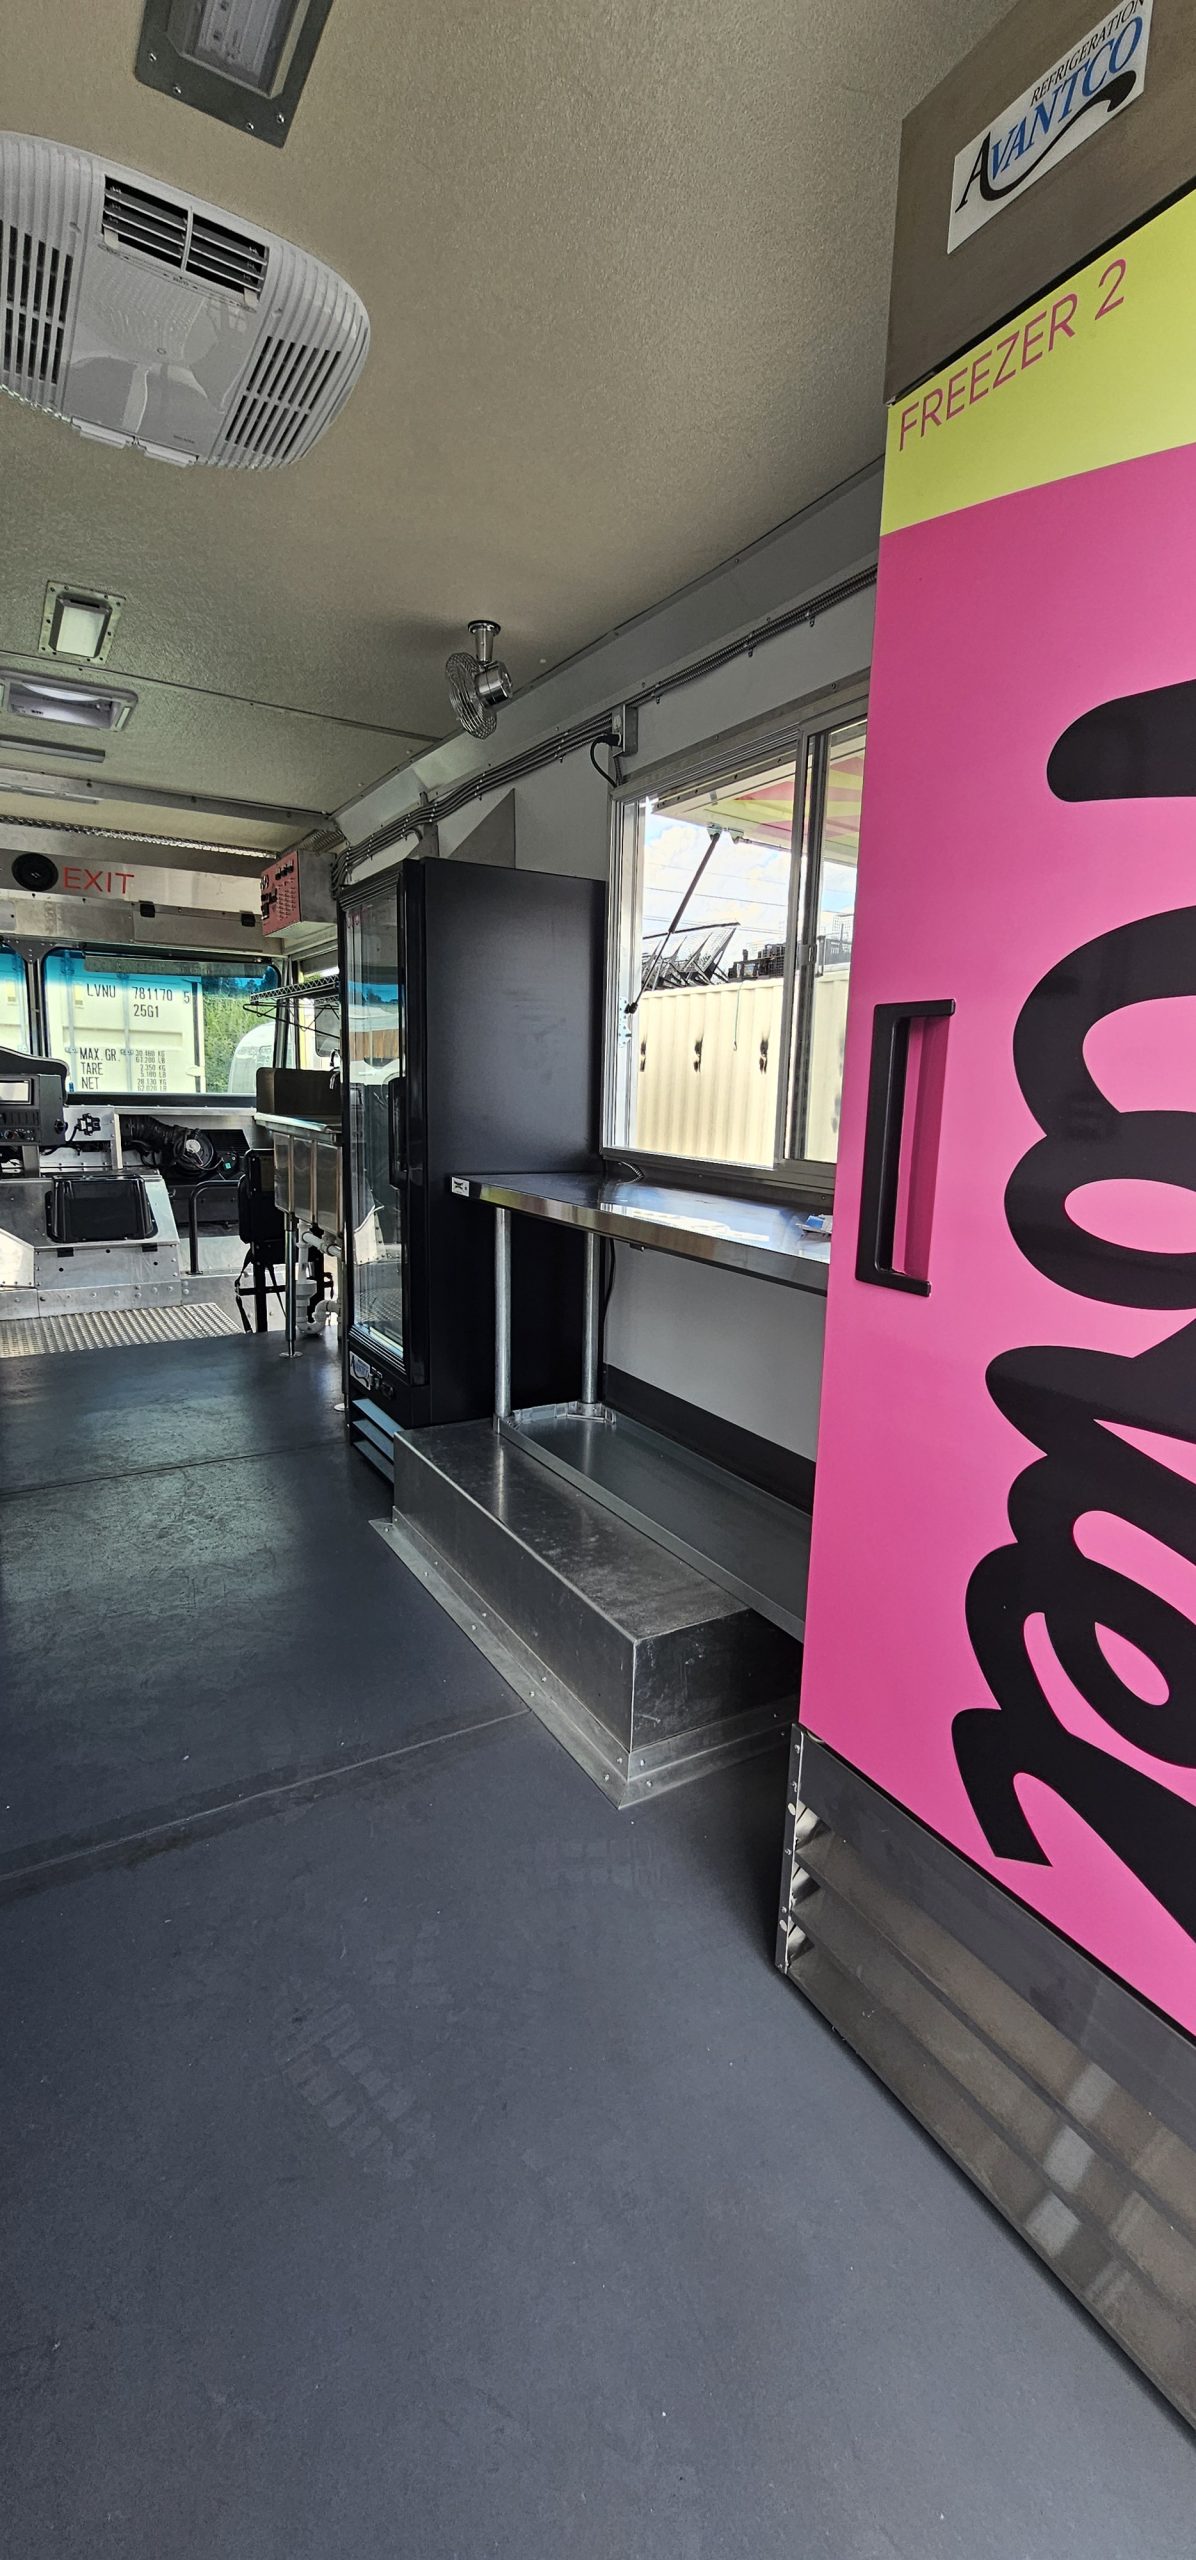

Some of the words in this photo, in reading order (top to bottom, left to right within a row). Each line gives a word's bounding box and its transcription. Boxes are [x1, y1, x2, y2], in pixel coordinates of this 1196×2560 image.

[955, 16, 1143, 213] AVANTCO
[898, 293, 1079, 451] FREEZER
[1094, 258, 1127, 321] 2
[64, 867, 135, 894] EXIT
[86, 983, 116, 998] LVNU
[132, 986, 173, 1001] 781170
[183, 990, 190, 1004] 5
[133, 1004, 159, 1018] 25G1
[80, 1062, 103, 1076] TARE
[81, 1076, 100, 1090] NET
